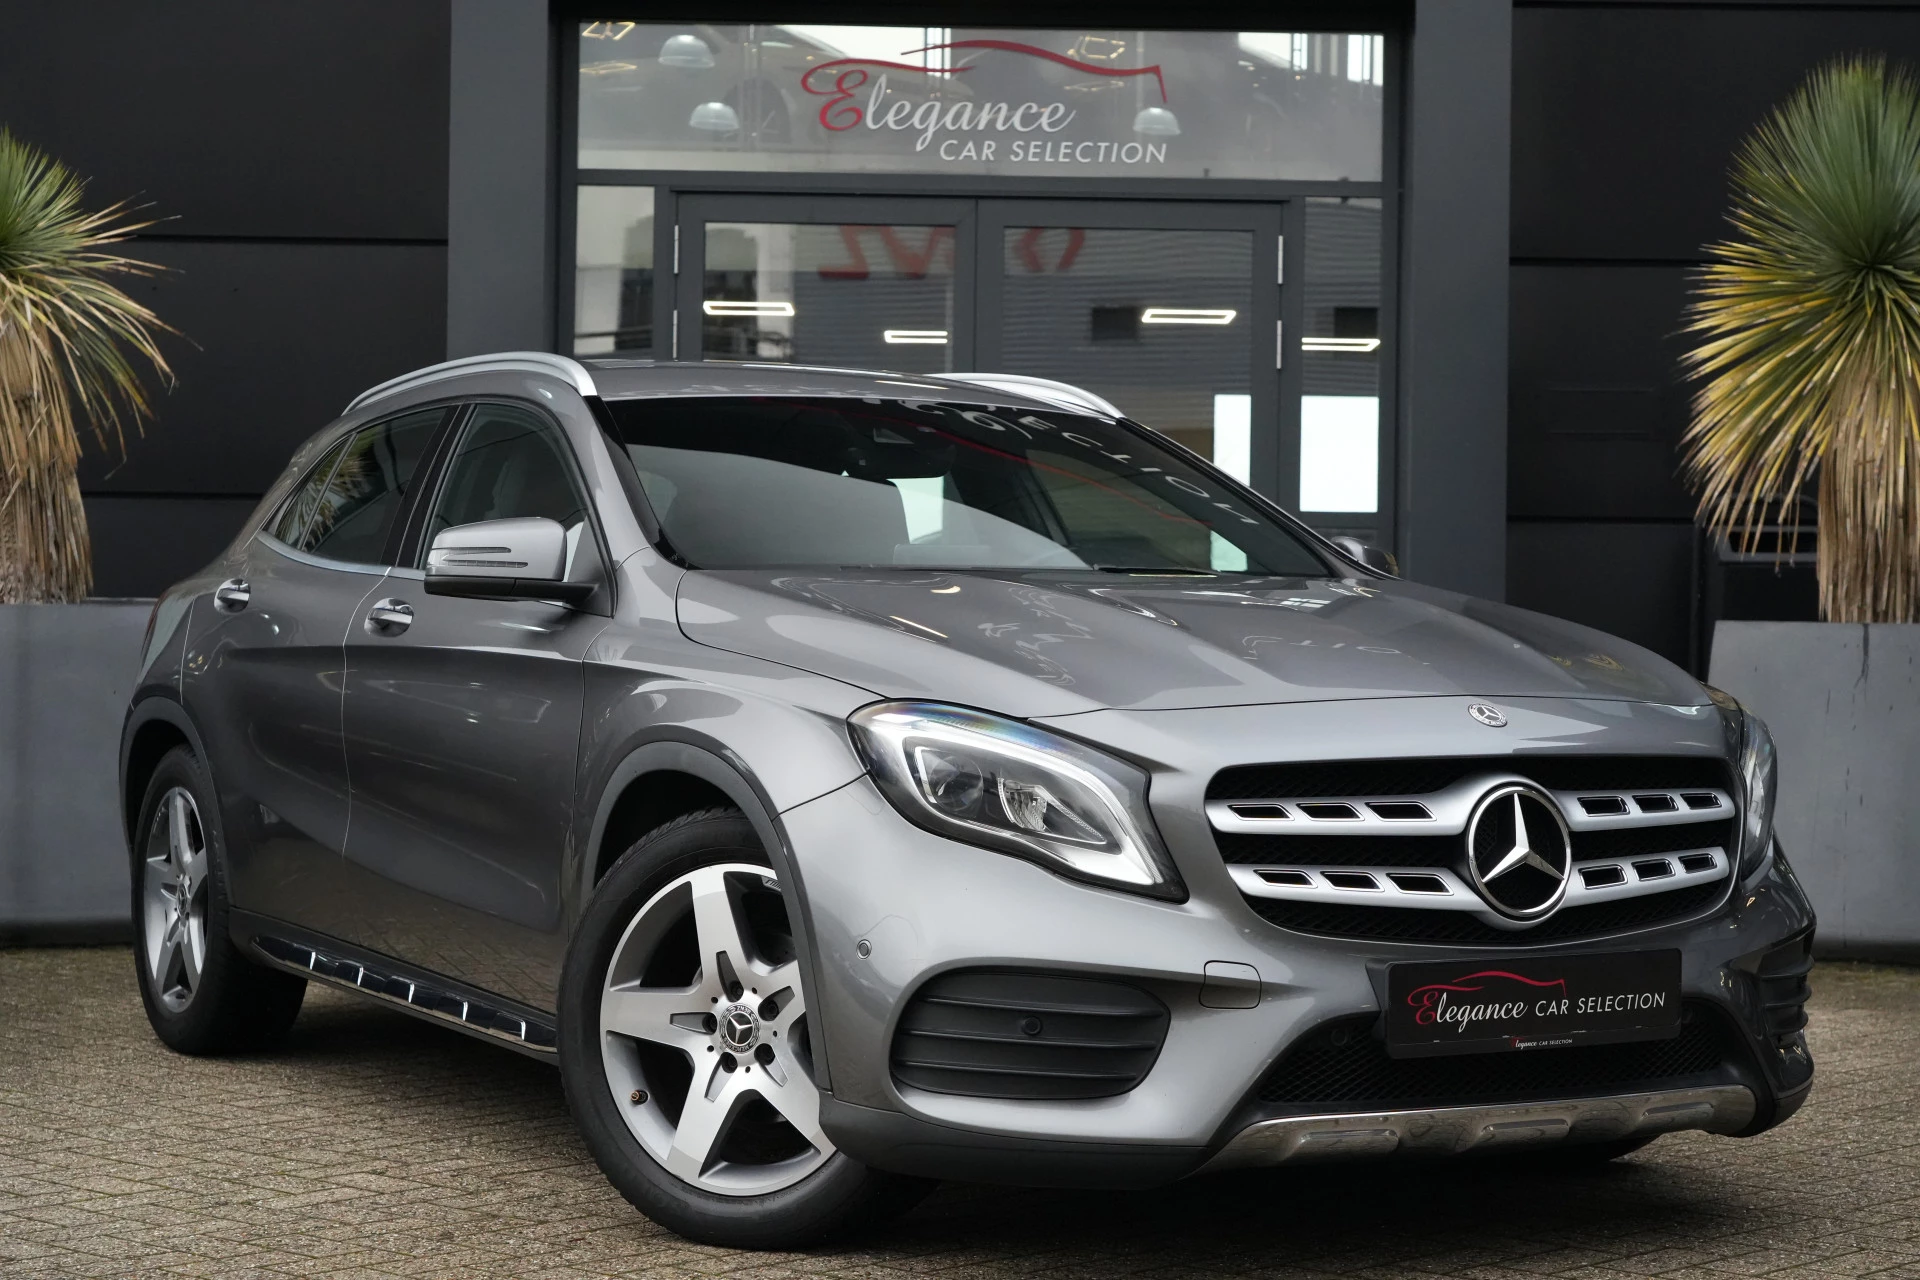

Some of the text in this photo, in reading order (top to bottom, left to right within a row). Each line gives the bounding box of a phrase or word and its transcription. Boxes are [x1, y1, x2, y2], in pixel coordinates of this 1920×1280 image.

[801, 59, 1076, 151] Elegance
[939, 140, 1167, 163] CAR SELECTION
[1407, 984, 1665, 1033] Elegance CAR SELECTION
